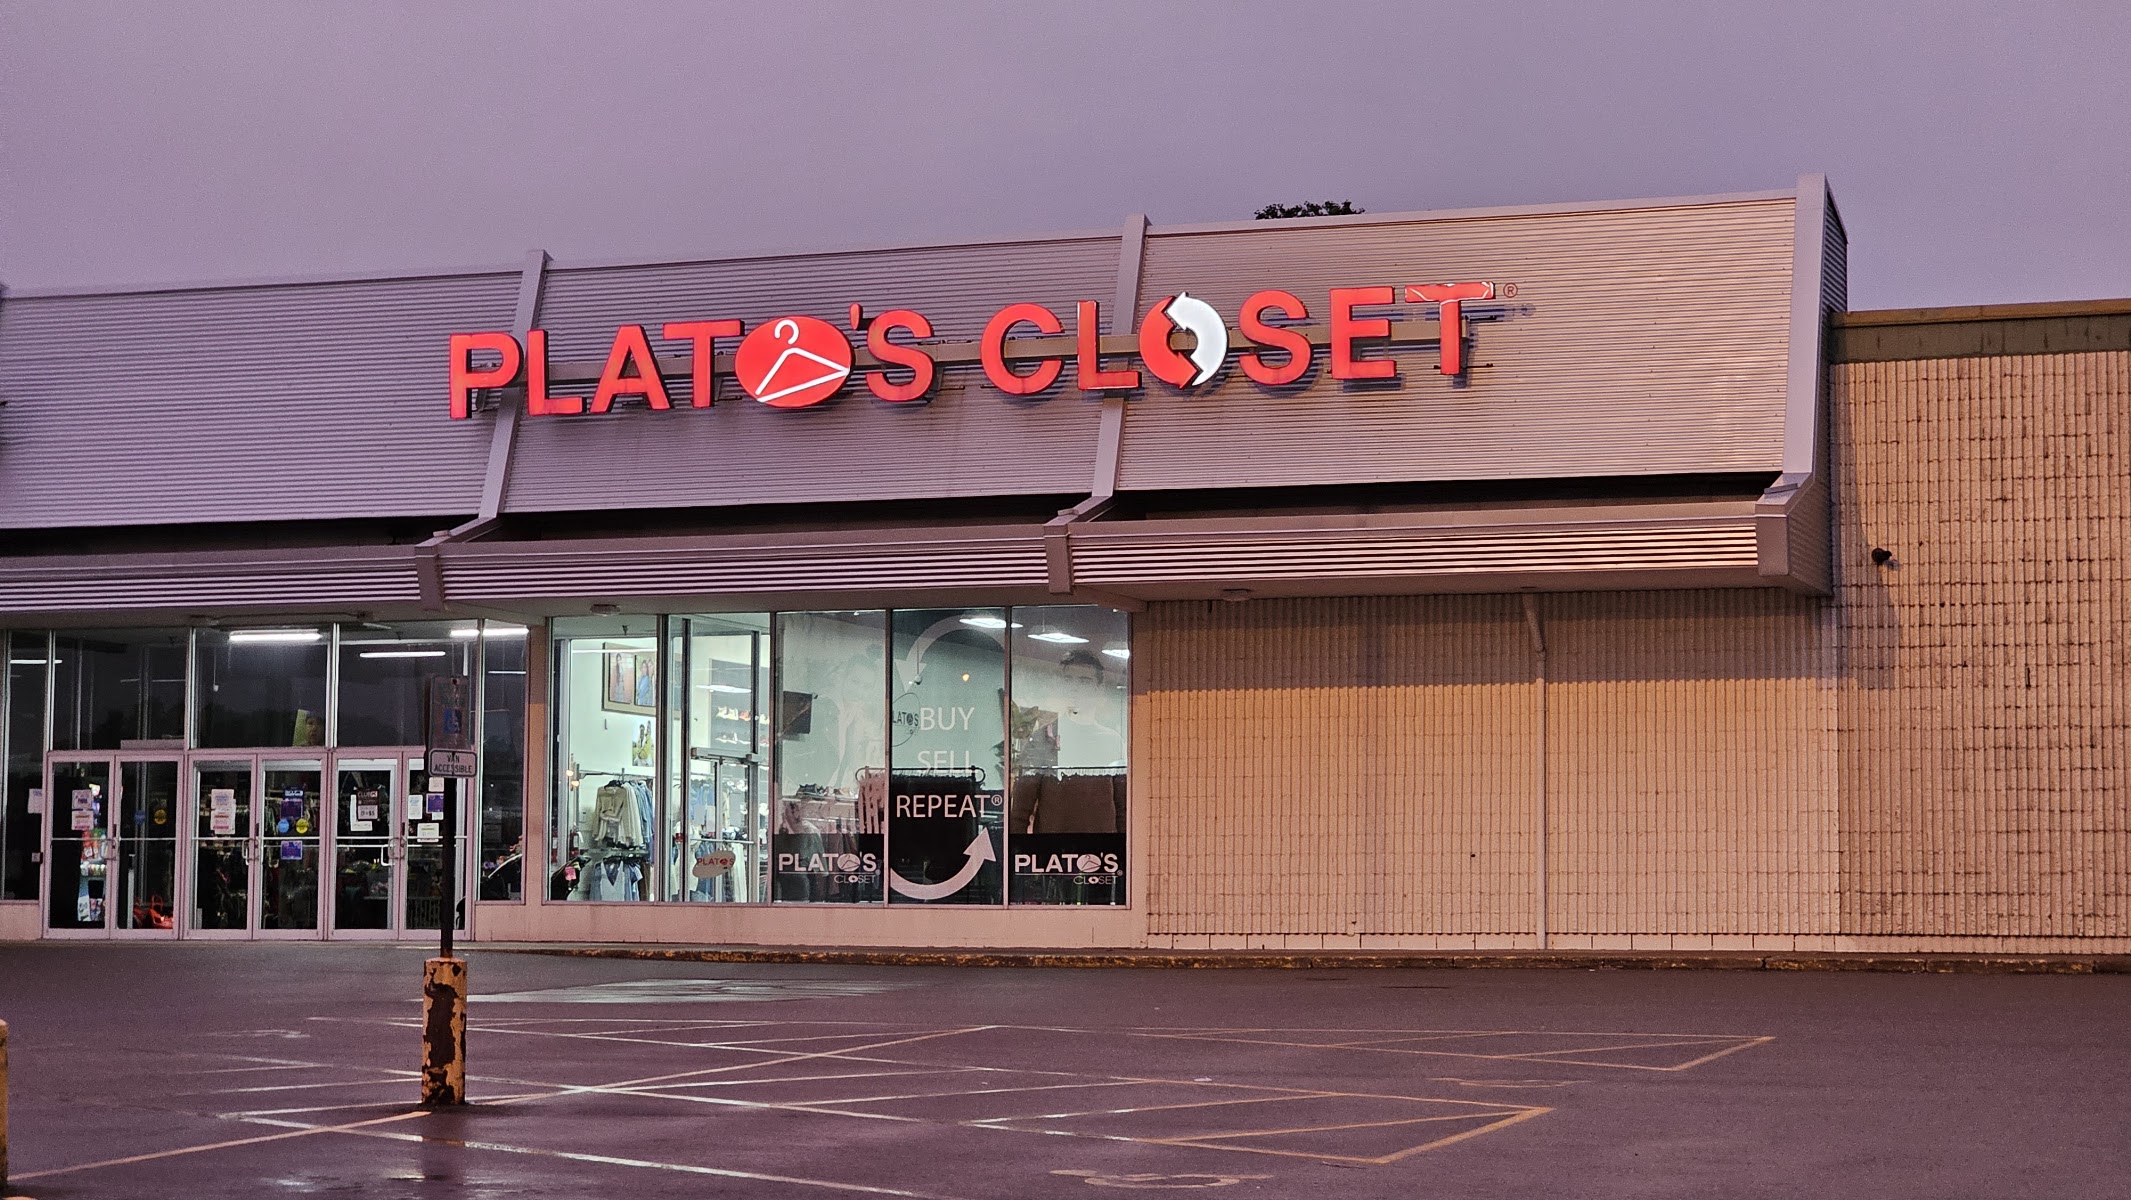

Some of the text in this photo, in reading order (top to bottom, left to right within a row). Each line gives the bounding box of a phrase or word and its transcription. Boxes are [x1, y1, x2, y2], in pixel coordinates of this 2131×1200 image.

[449, 303, 935, 419] PLATO'S
[920, 707, 975, 731] BUY
[433, 764, 473, 774] ACCESSIBLE
[447, 755, 460, 763] VAN
[917, 750, 978, 774] SELL
[778, 851, 877, 872] PLATO'S
[1014, 852, 1119, 873] PLATO'S
[834, 874, 877, 884] CLOSET
[1073, 875, 1118, 885] CLOSET
